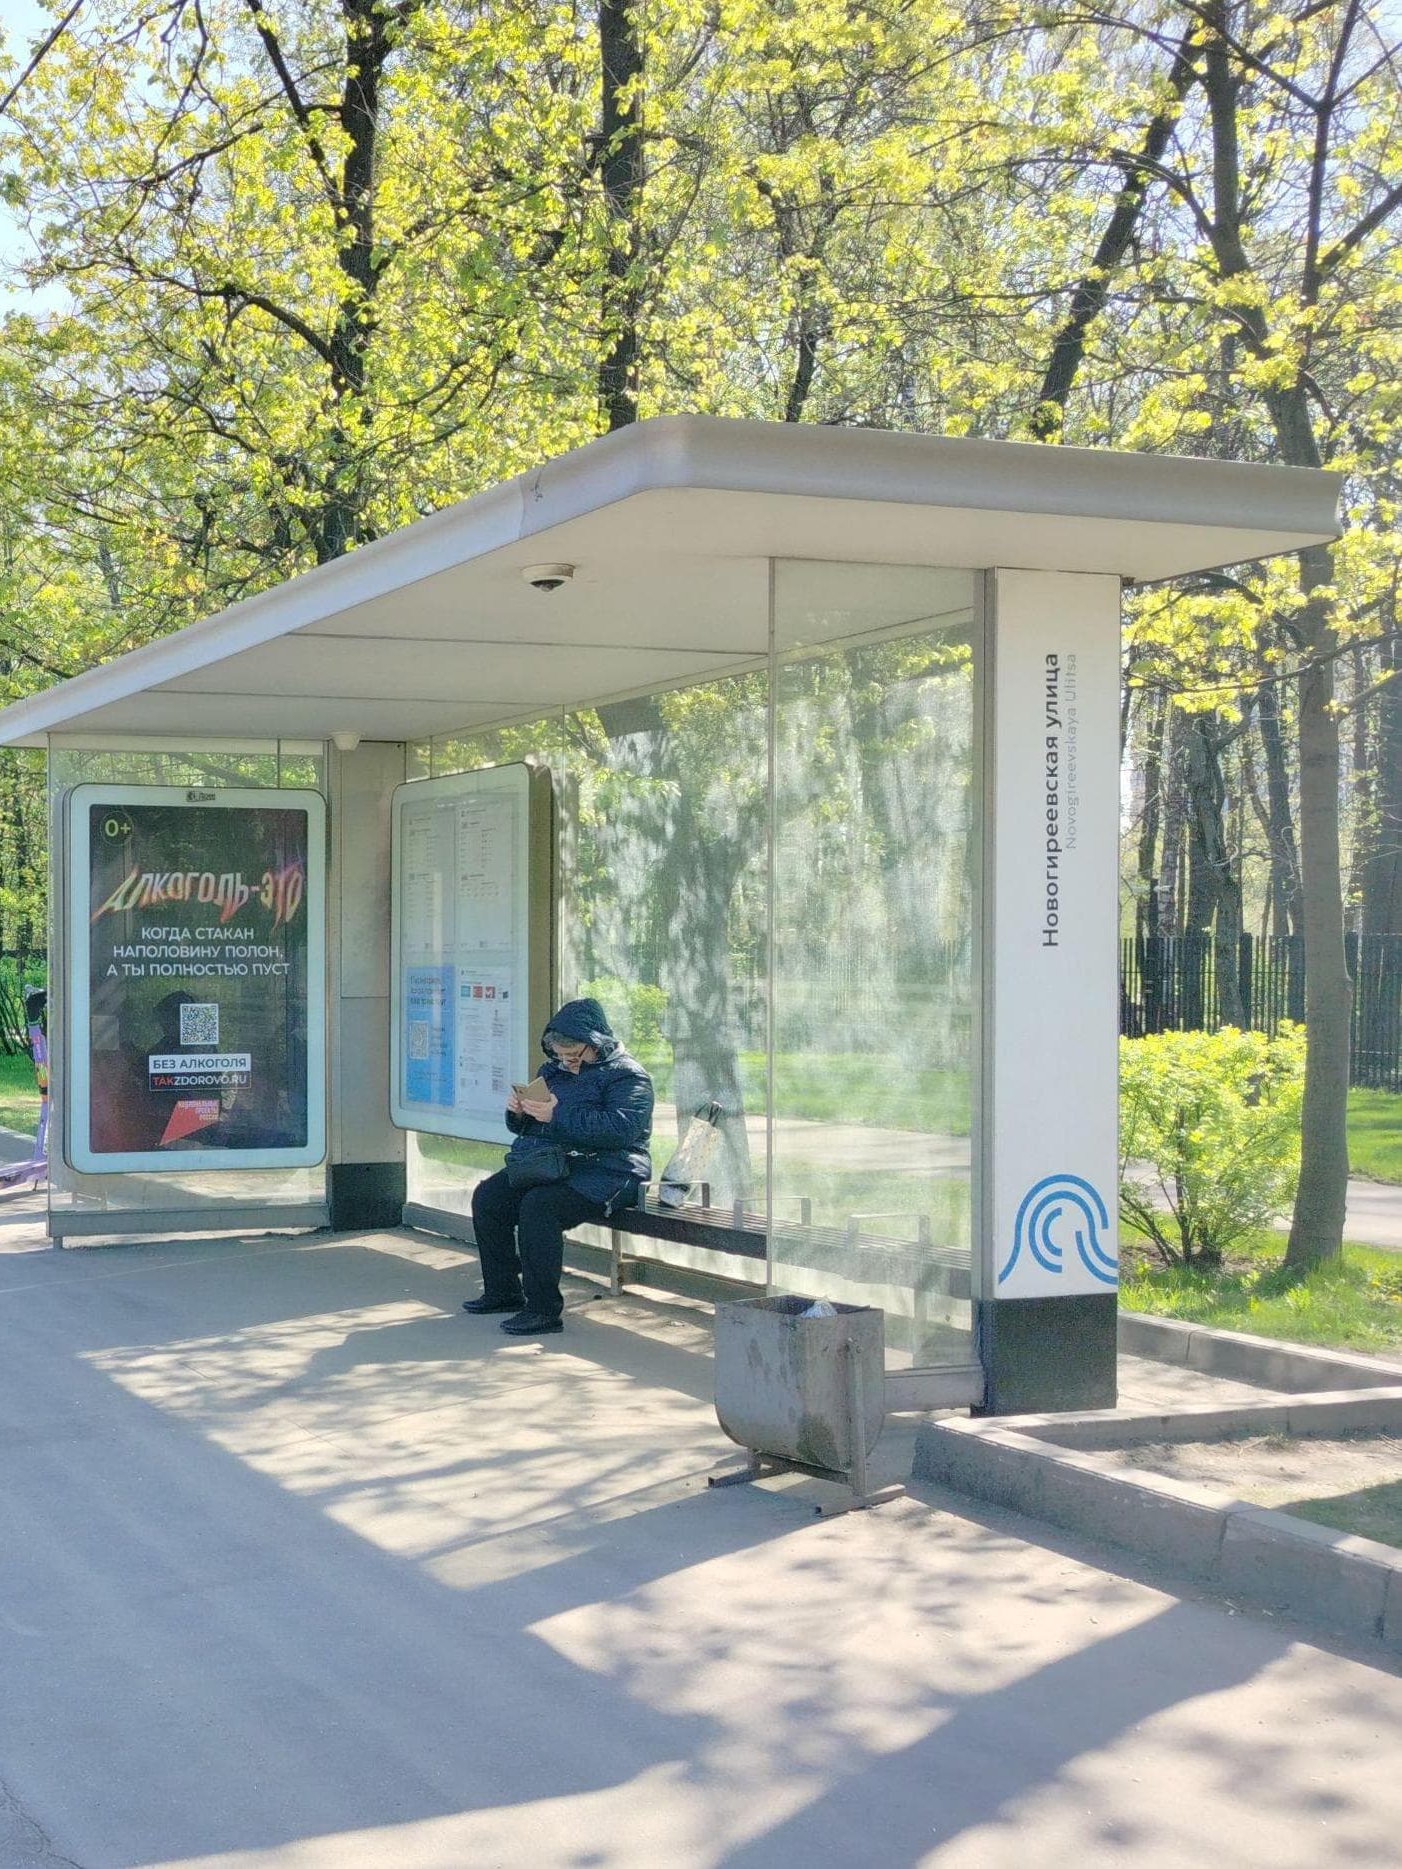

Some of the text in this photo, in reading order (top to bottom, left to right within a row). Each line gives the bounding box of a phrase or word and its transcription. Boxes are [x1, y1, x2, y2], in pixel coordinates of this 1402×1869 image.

[1065, 653, 1079, 849] Novogireevskaya Ulitsa
[1042, 653, 1062, 947] Новогиреевская улица
[104, 819, 132, 837] 0+
[141, 927, 255, 942] КОГДА СТАКАН
[113, 945, 284, 960] НАПОЛОВИНУ ПОЛОН,
[106, 963, 291, 976] А ТЫ ПОЛНОСТЬЮ ПУСТ
[153, 1058, 247, 1069] БЕЗ АЛКОГОЛЯ
